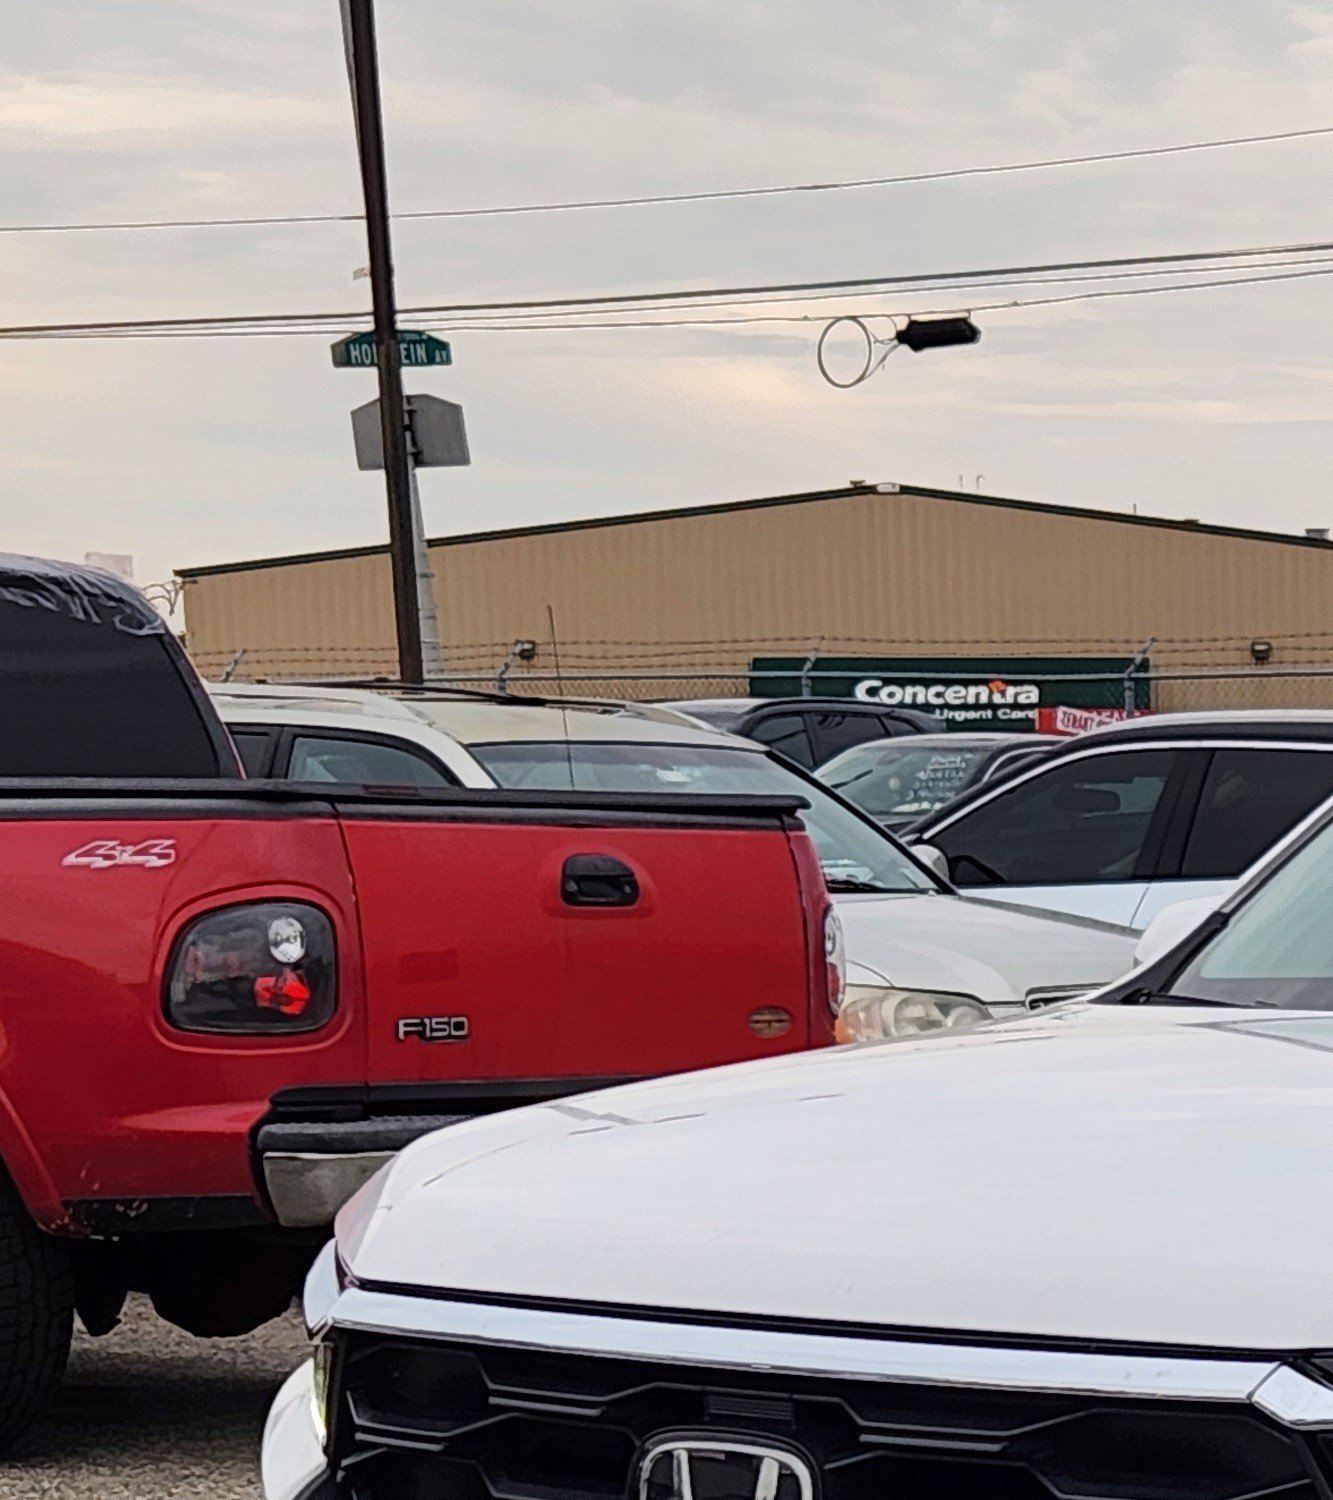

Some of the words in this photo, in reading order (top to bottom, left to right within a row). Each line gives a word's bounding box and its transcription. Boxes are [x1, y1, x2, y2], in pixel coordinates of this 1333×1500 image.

[349, 342, 428, 365] HOLEIN
[855, 680, 1040, 704] Concentra
[934, 708, 993, 720] Urgent
[398, 1017, 469, 1040] F150
